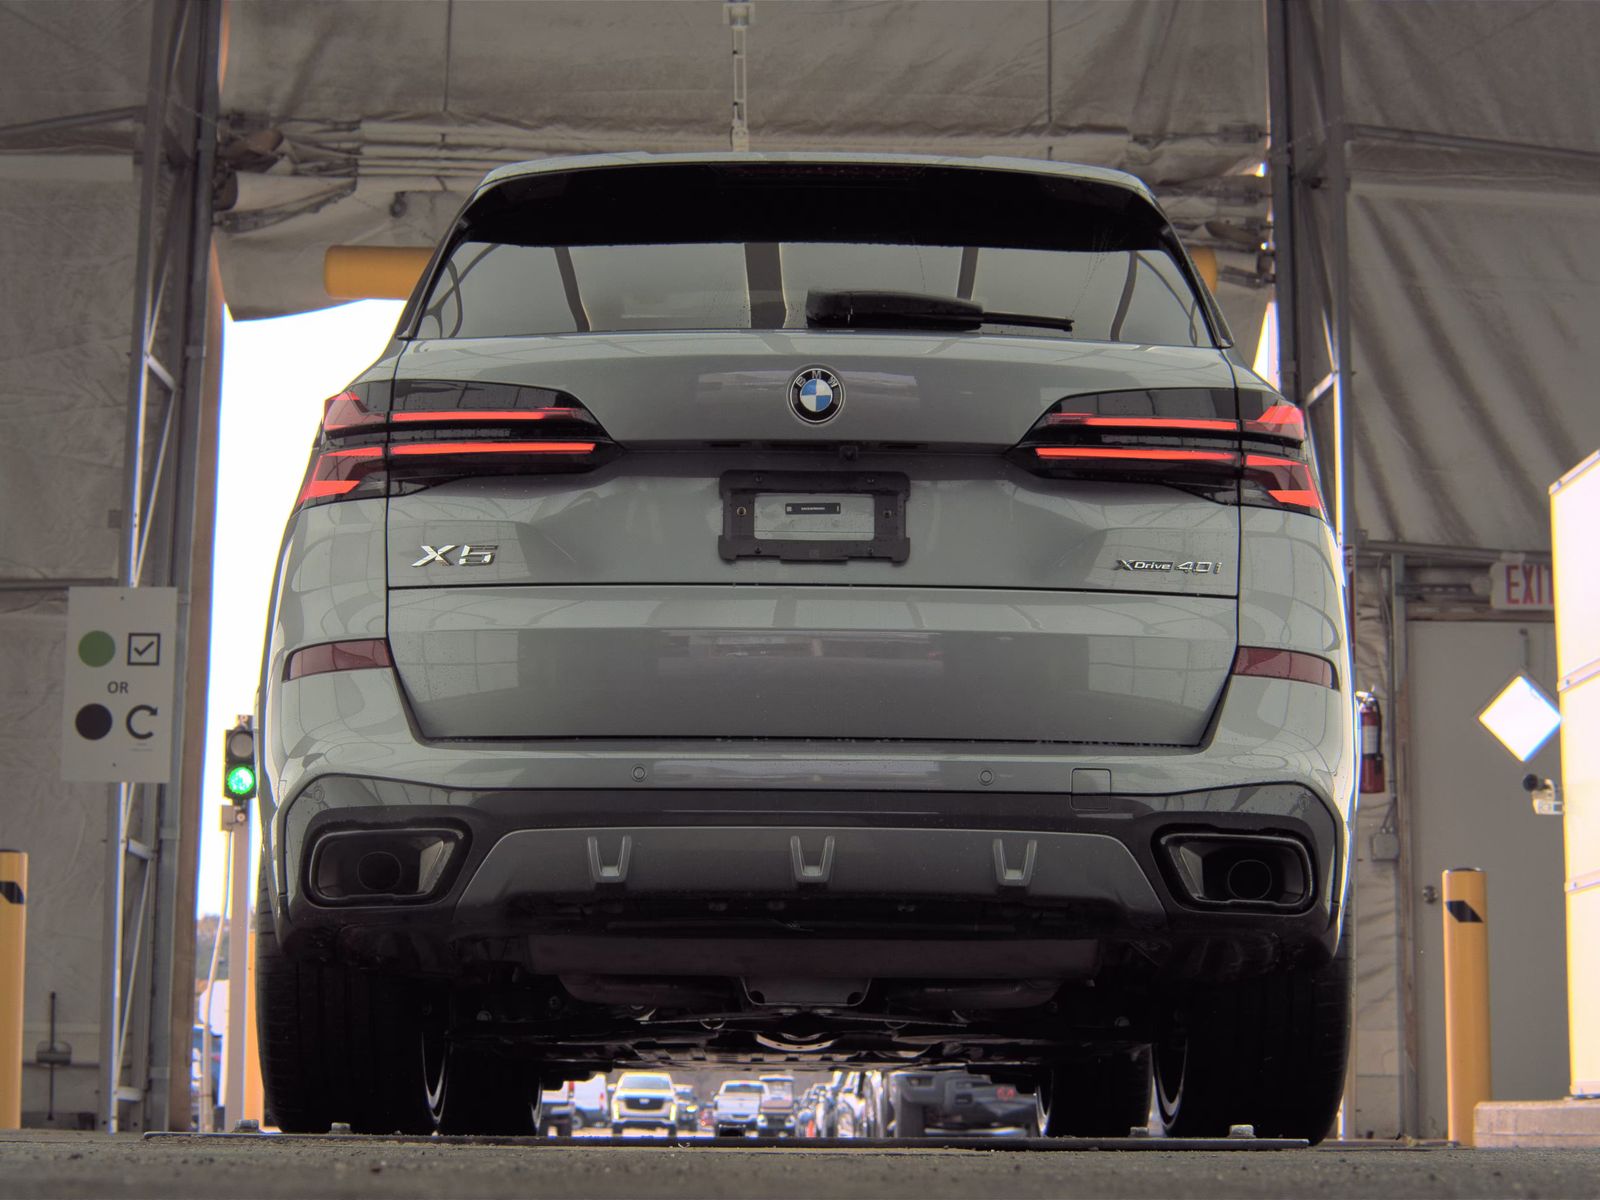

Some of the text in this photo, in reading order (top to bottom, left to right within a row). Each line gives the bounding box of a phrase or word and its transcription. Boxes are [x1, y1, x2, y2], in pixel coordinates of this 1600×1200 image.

[795, 370, 838, 387] BMW
[411, 545, 498, 567] X5
[107, 681, 129, 694] OR
